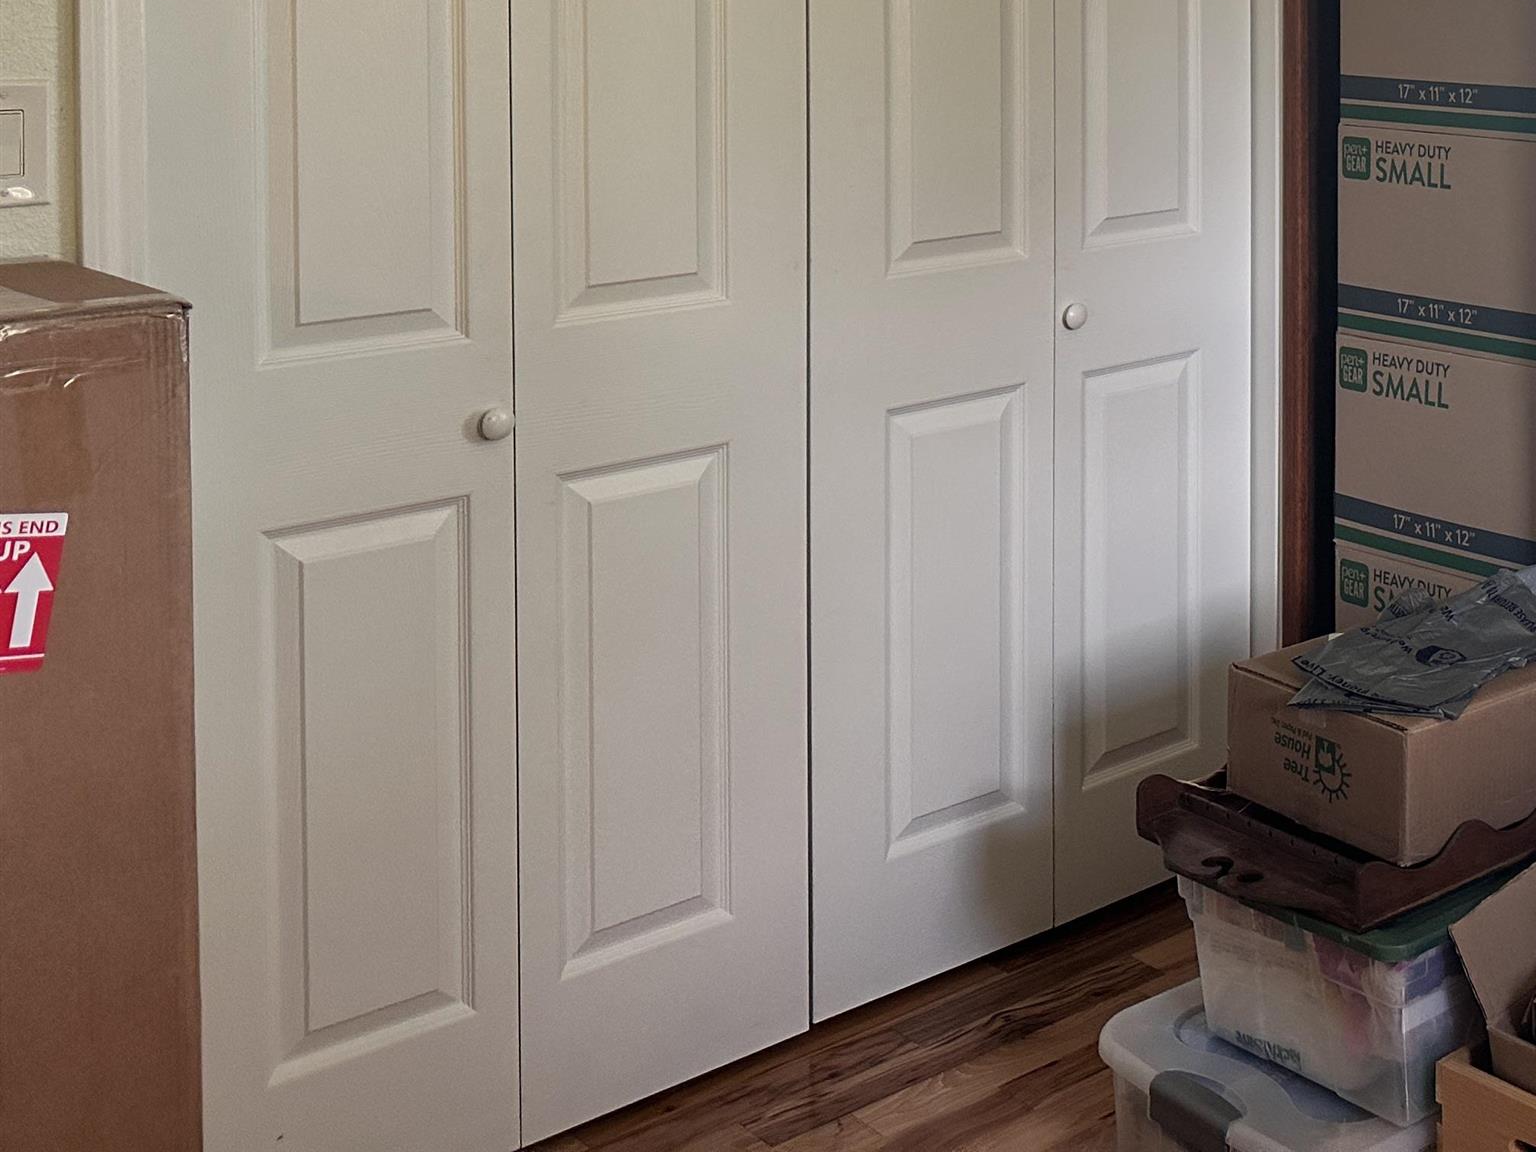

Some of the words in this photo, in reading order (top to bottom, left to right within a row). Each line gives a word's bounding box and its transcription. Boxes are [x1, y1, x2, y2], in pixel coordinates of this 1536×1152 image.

[1375, 140, 1415, 158] HEAVY
[1418, 144, 1452, 160] DUTY
[1346, 154, 1367, 173] GEAR
[1375, 157, 1452, 190] SMALL
[1342, 365, 1363, 385] GEAR
[1372, 352, 1413, 371] HEAVY
[1415, 359, 1450, 378] DUTY
[1372, 370, 1449, 409] SMALL
[19, 520, 59, 535] END
[1343, 578, 1364, 598] GEAR
[1373, 568, 1415, 589] HEAVY
[1274, 731, 1311, 760] House
[1283, 757, 1310, 783] Tree
